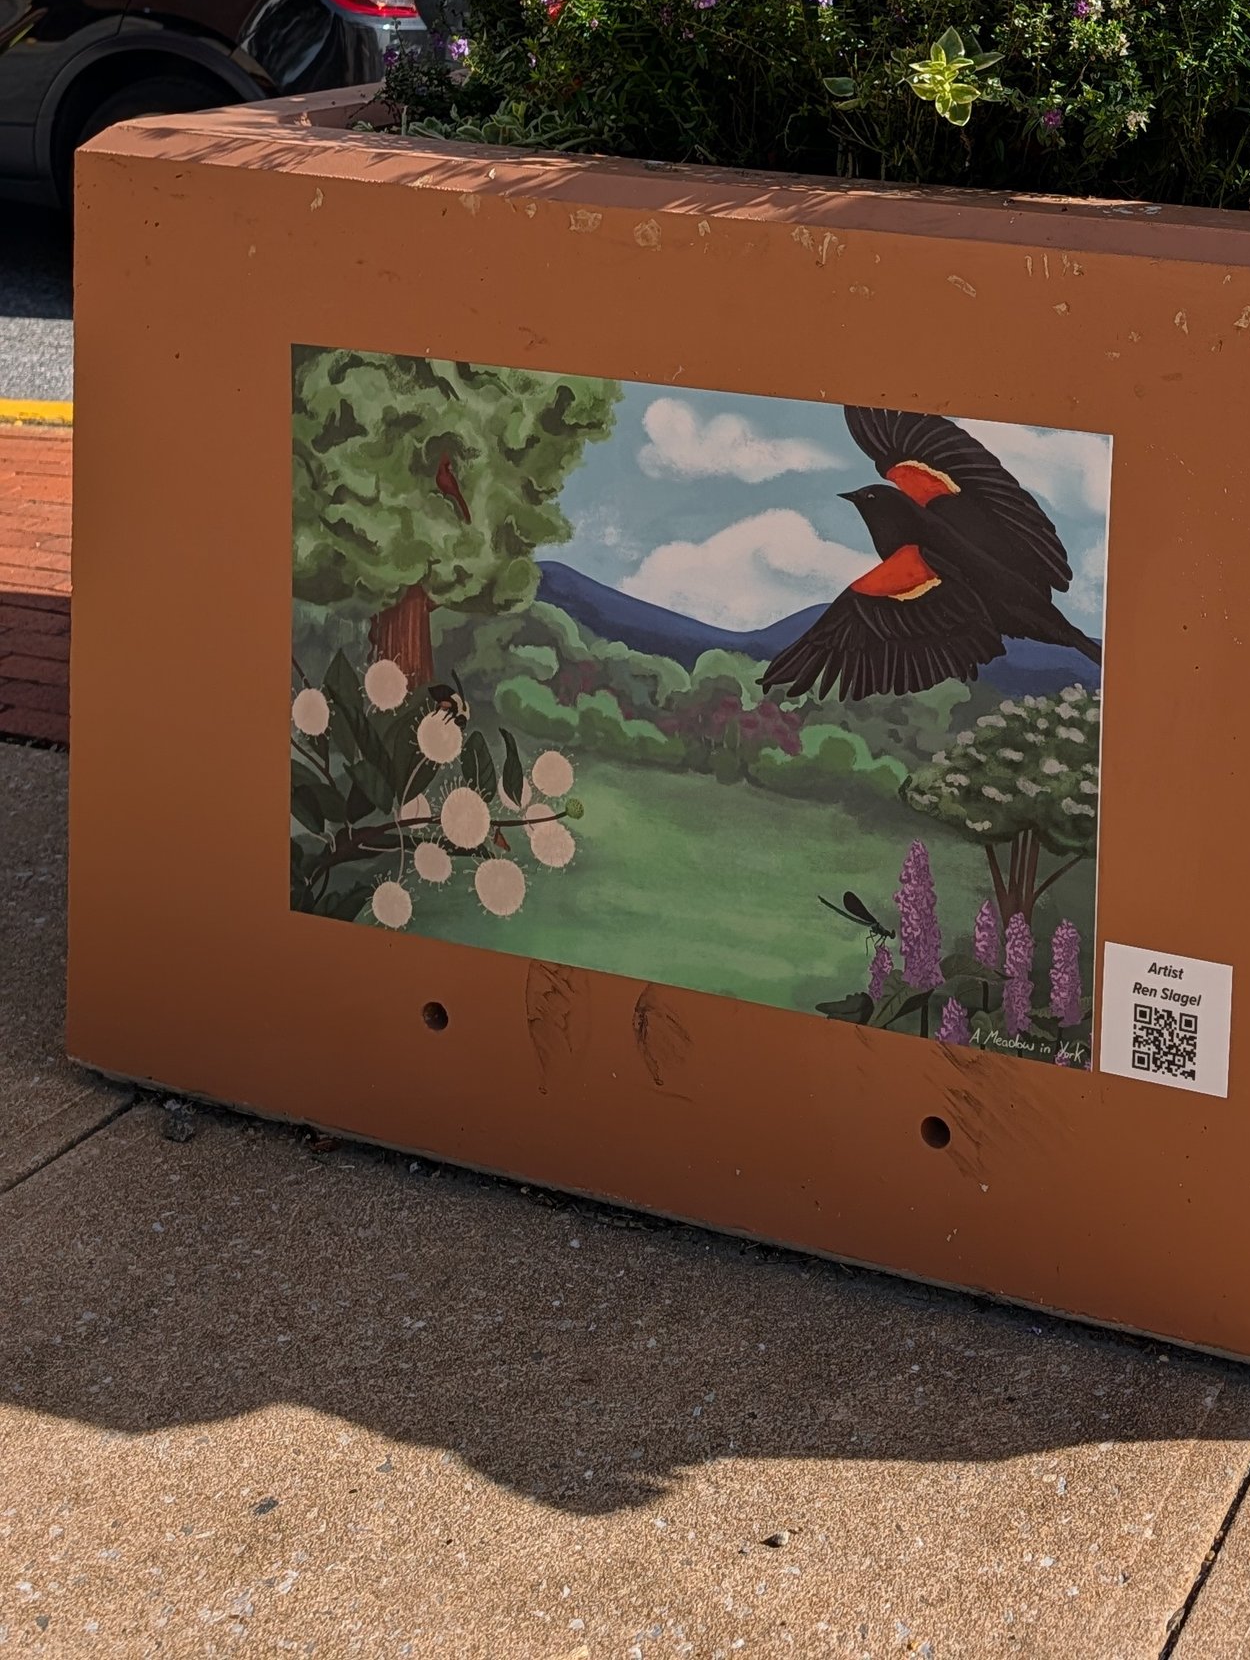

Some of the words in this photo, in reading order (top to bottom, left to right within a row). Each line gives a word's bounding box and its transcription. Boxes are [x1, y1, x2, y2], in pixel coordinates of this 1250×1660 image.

[1147, 962, 1184, 980] Artist
[1132, 982, 1158, 998] Ren
[1160, 987, 1202, 1007] Slagel
[968, 1027, 981, 1044] A
[983, 1029, 1035, 1051] Meadow
[1040, 1043, 1051, 1054] in
